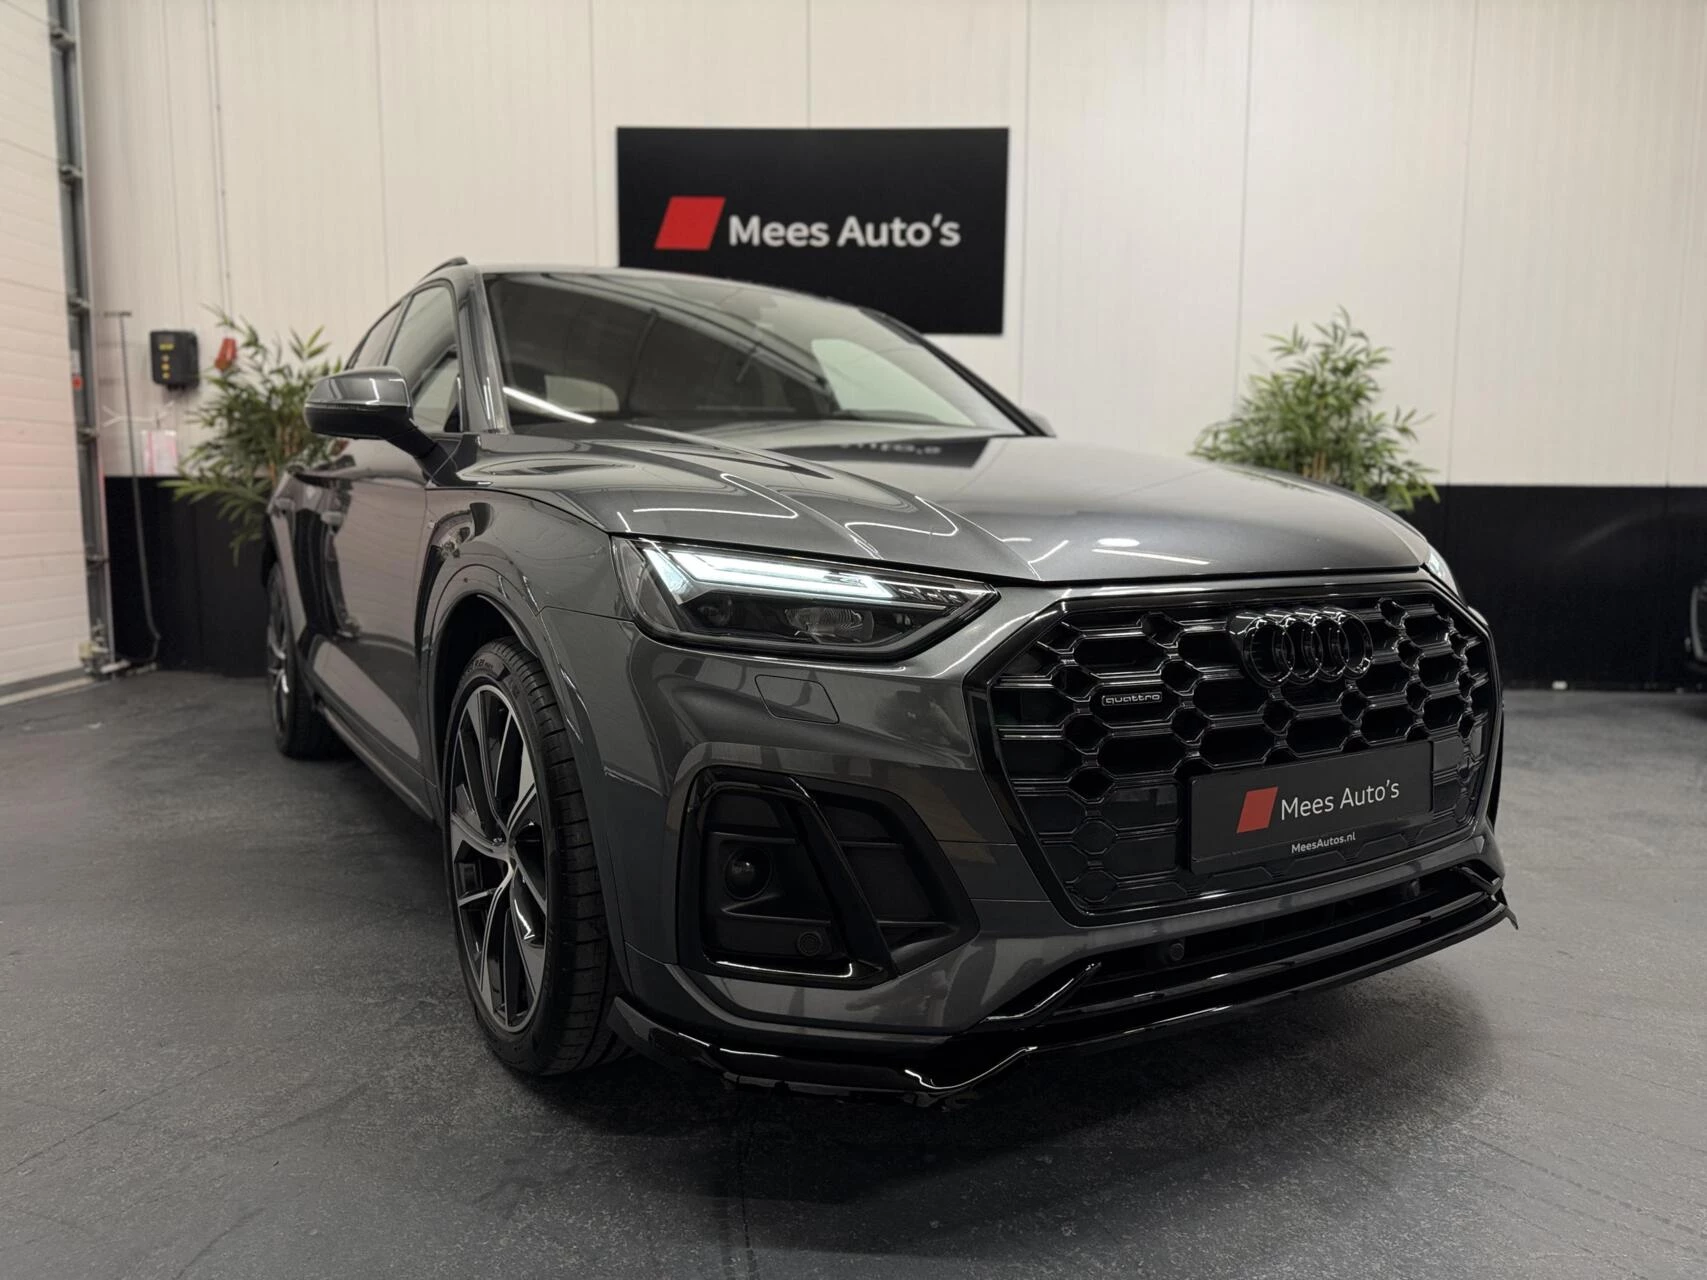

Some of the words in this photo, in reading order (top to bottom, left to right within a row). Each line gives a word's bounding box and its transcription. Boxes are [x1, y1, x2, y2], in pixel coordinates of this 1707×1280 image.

[729, 214, 830, 247] Mees
[838, 213, 961, 247] Auto's
[1105, 694, 1160, 704] quattro
[1281, 797, 1335, 821] Mees
[1339, 779, 1400, 809] Auto's
[1291, 831, 1356, 854] MeesAutos.nl
